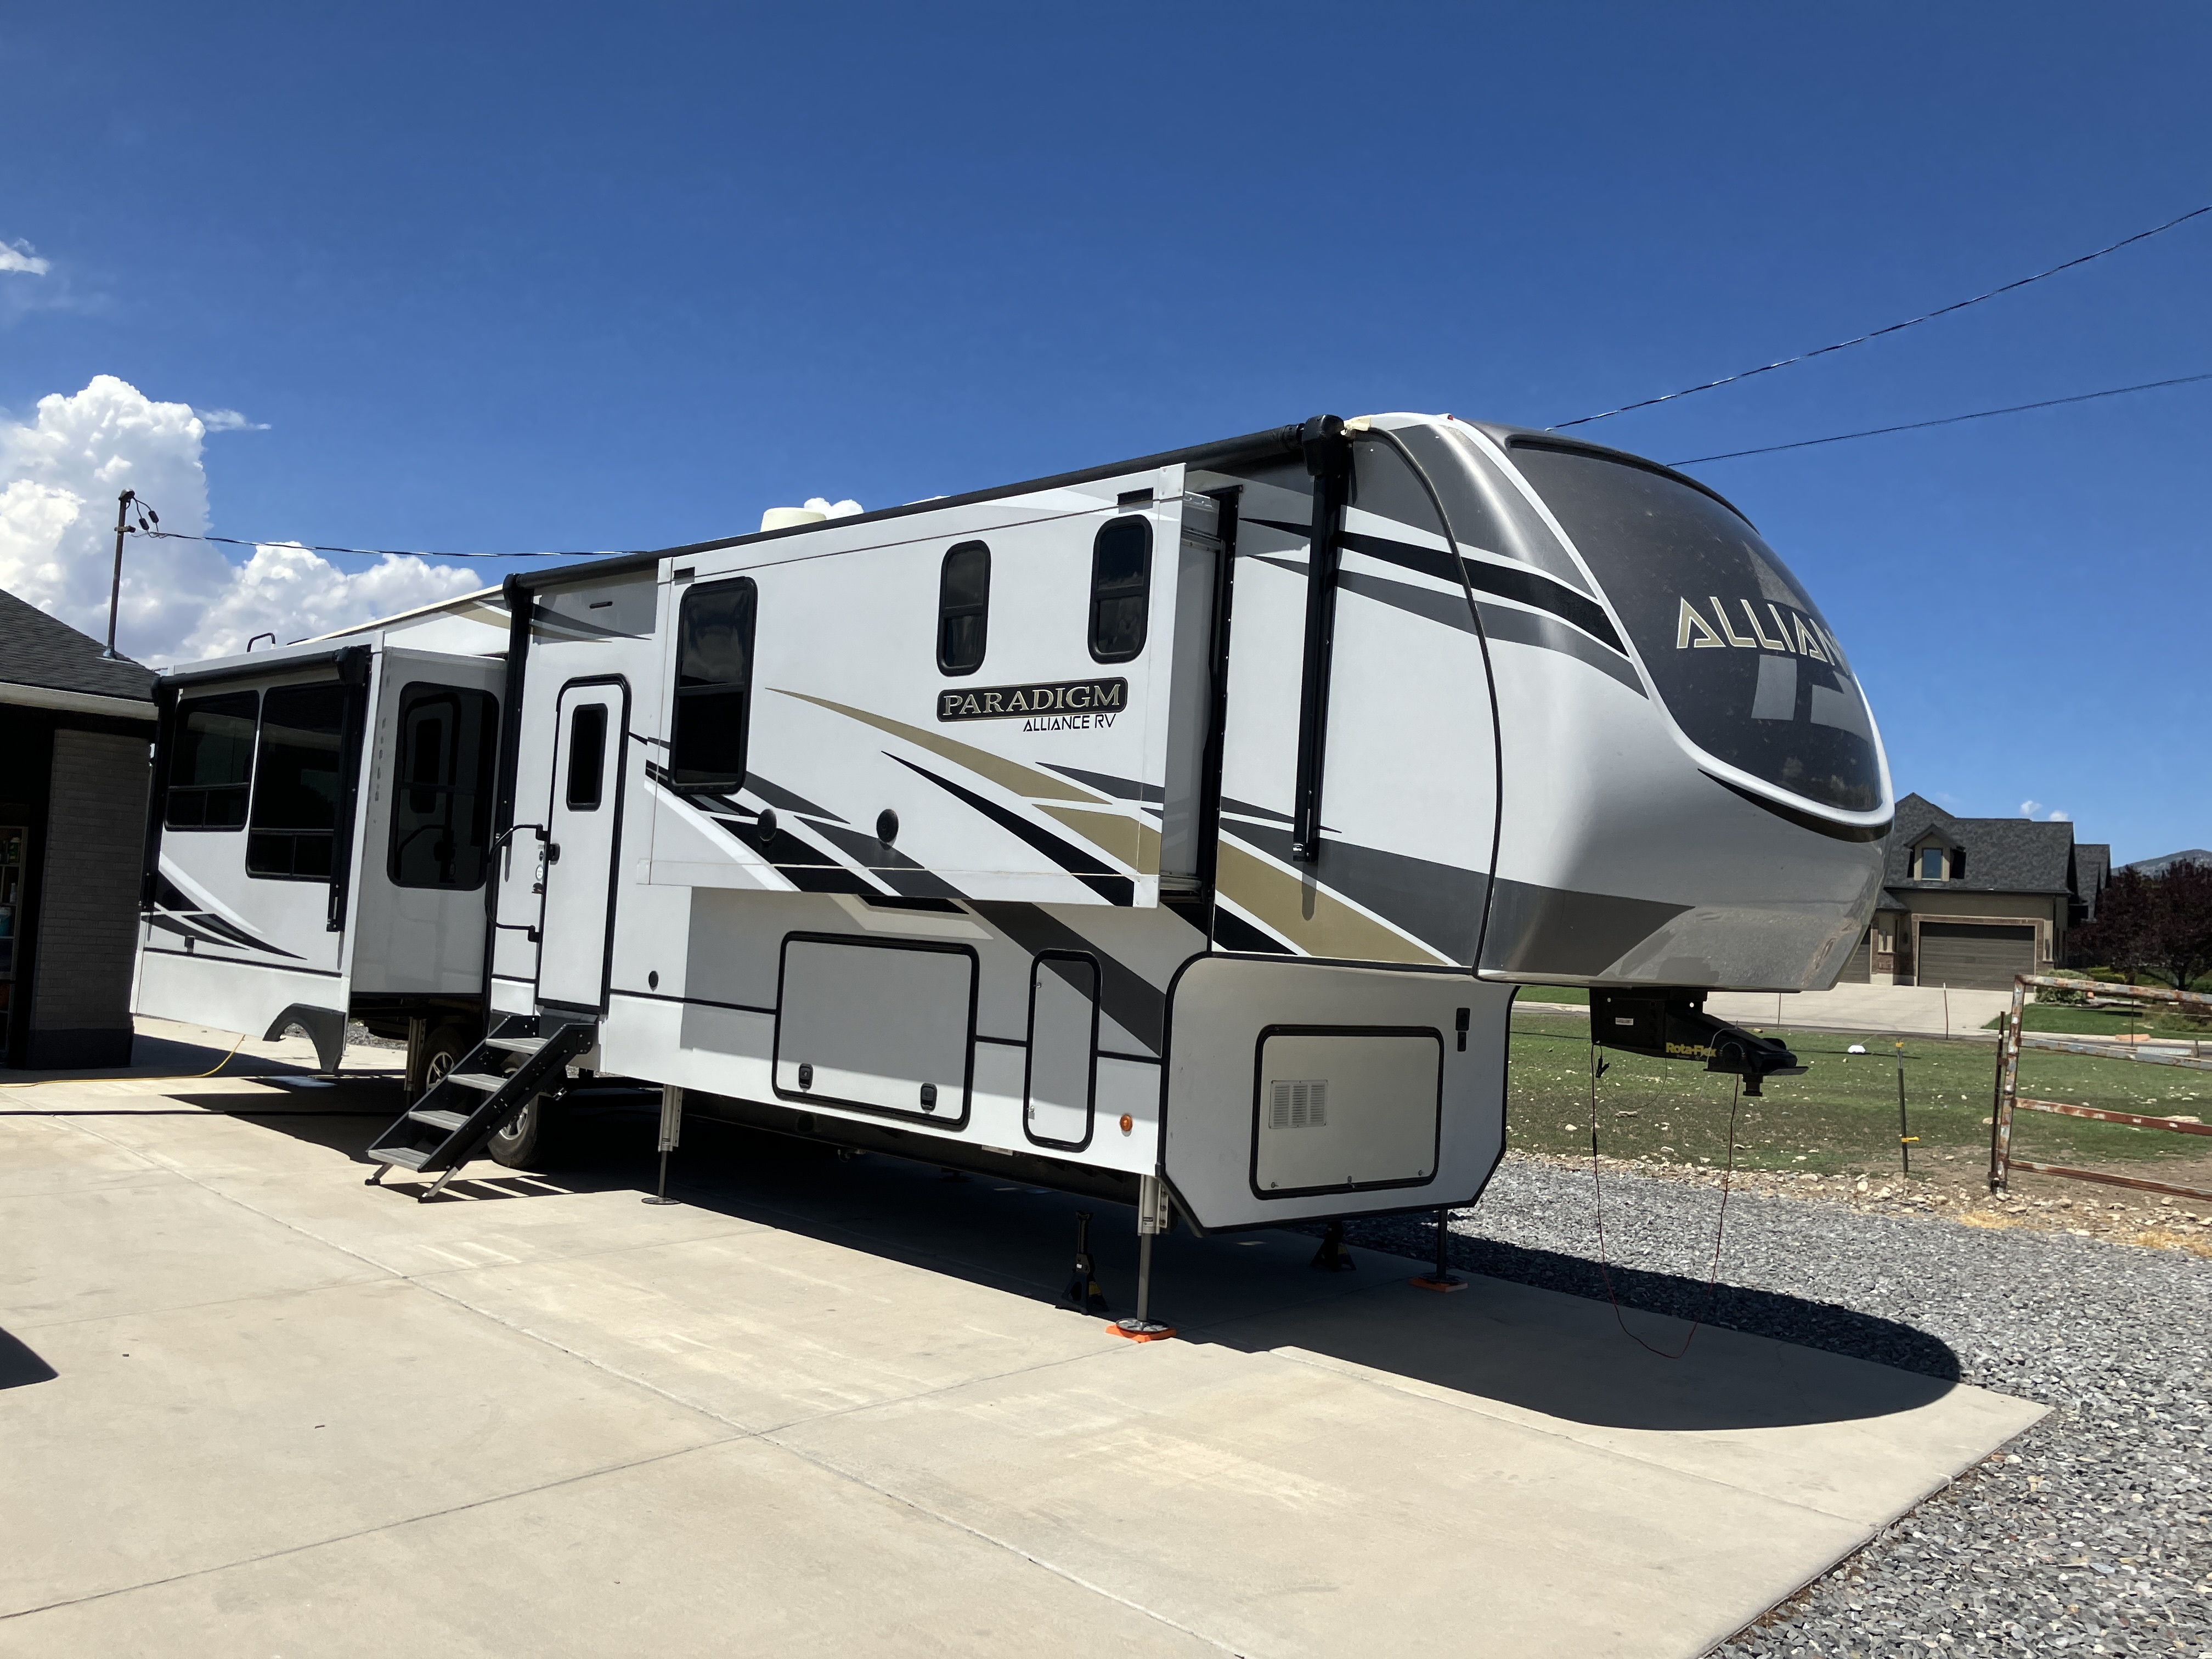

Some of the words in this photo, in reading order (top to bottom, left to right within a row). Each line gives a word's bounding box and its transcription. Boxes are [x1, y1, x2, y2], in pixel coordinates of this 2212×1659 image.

[943, 684, 1121, 715] PARADIGM
[1023, 715, 1090, 732] ALLIANCE
[1094, 714, 1116, 729] RV
